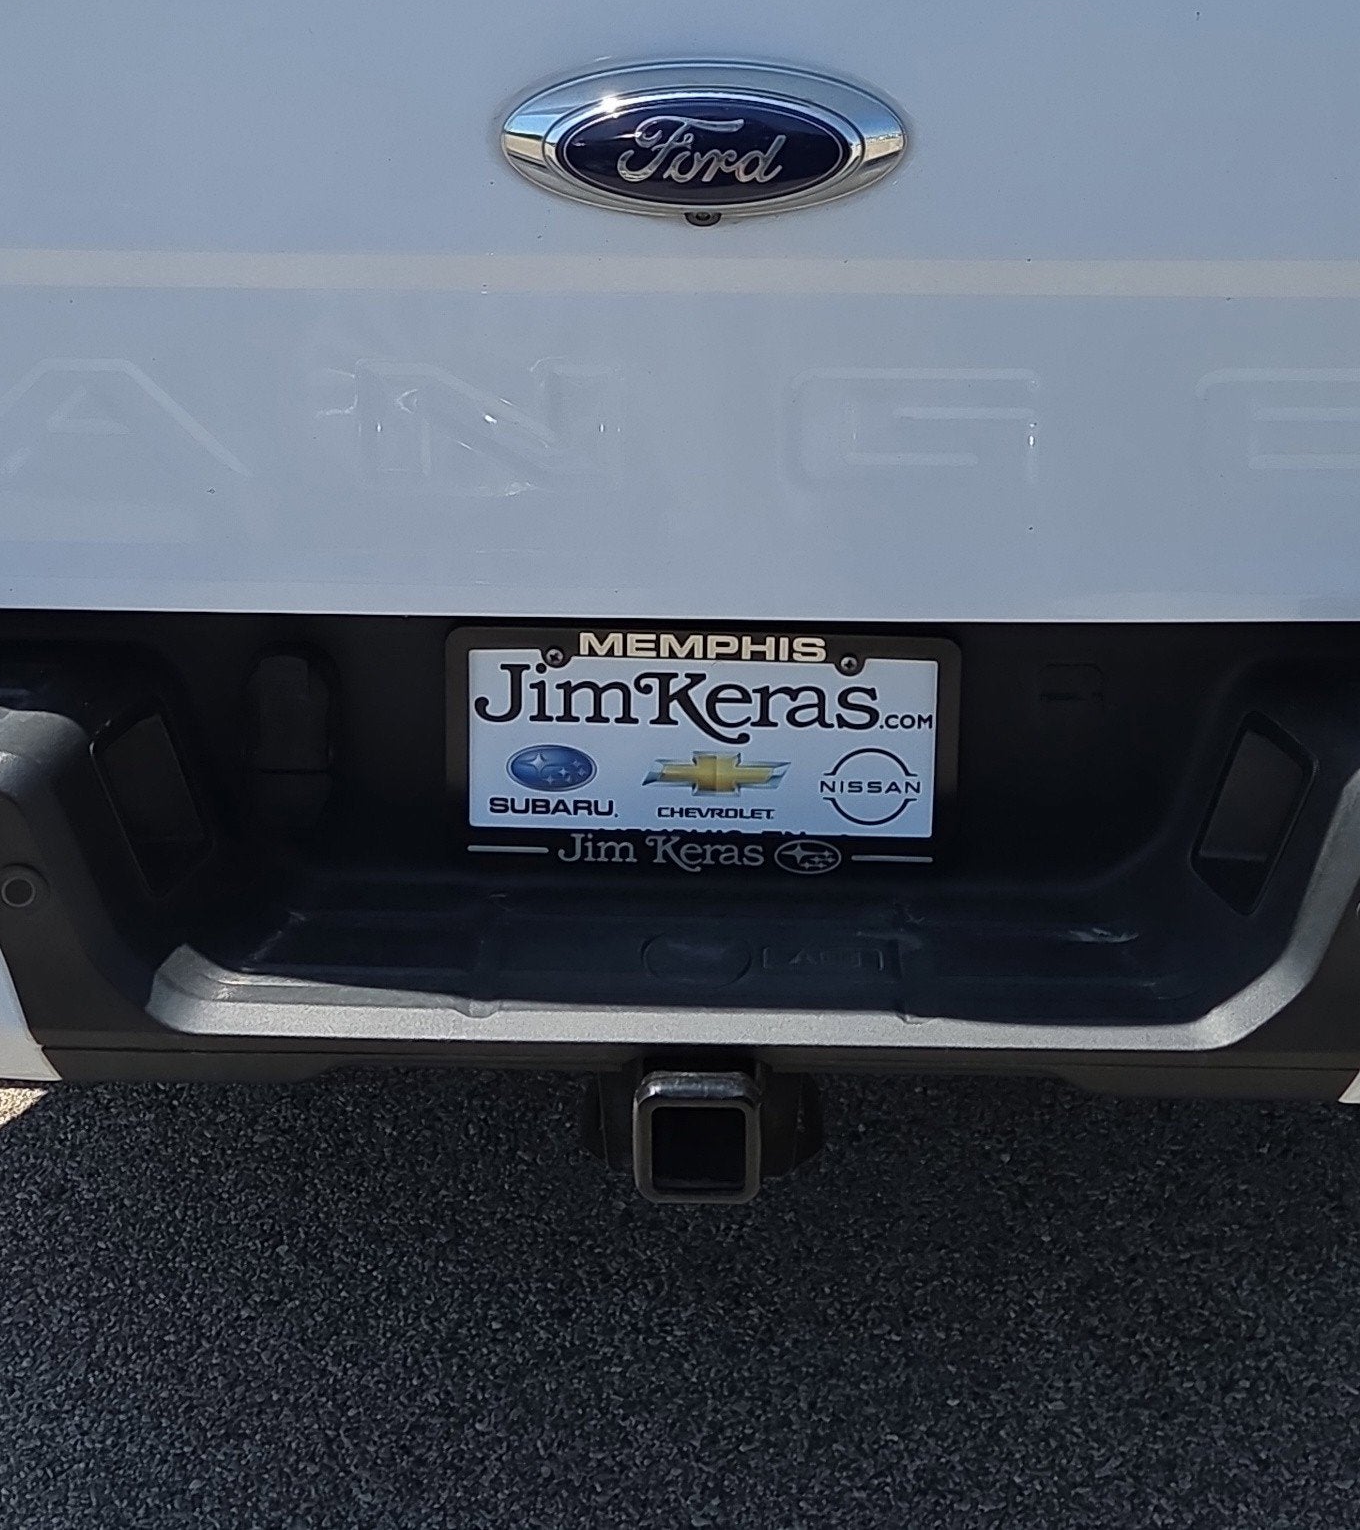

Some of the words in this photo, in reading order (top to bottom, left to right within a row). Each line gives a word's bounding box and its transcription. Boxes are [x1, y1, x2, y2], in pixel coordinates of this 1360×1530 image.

[616, 115, 787, 184] Ford
[579, 632, 827, 662] MEMPHIS
[820, 780, 921, 794] NISSAN
[657, 807, 776, 820] CHEVROLET
[558, 833, 638, 863] Jim
[645, 835, 764, 872] Keras
